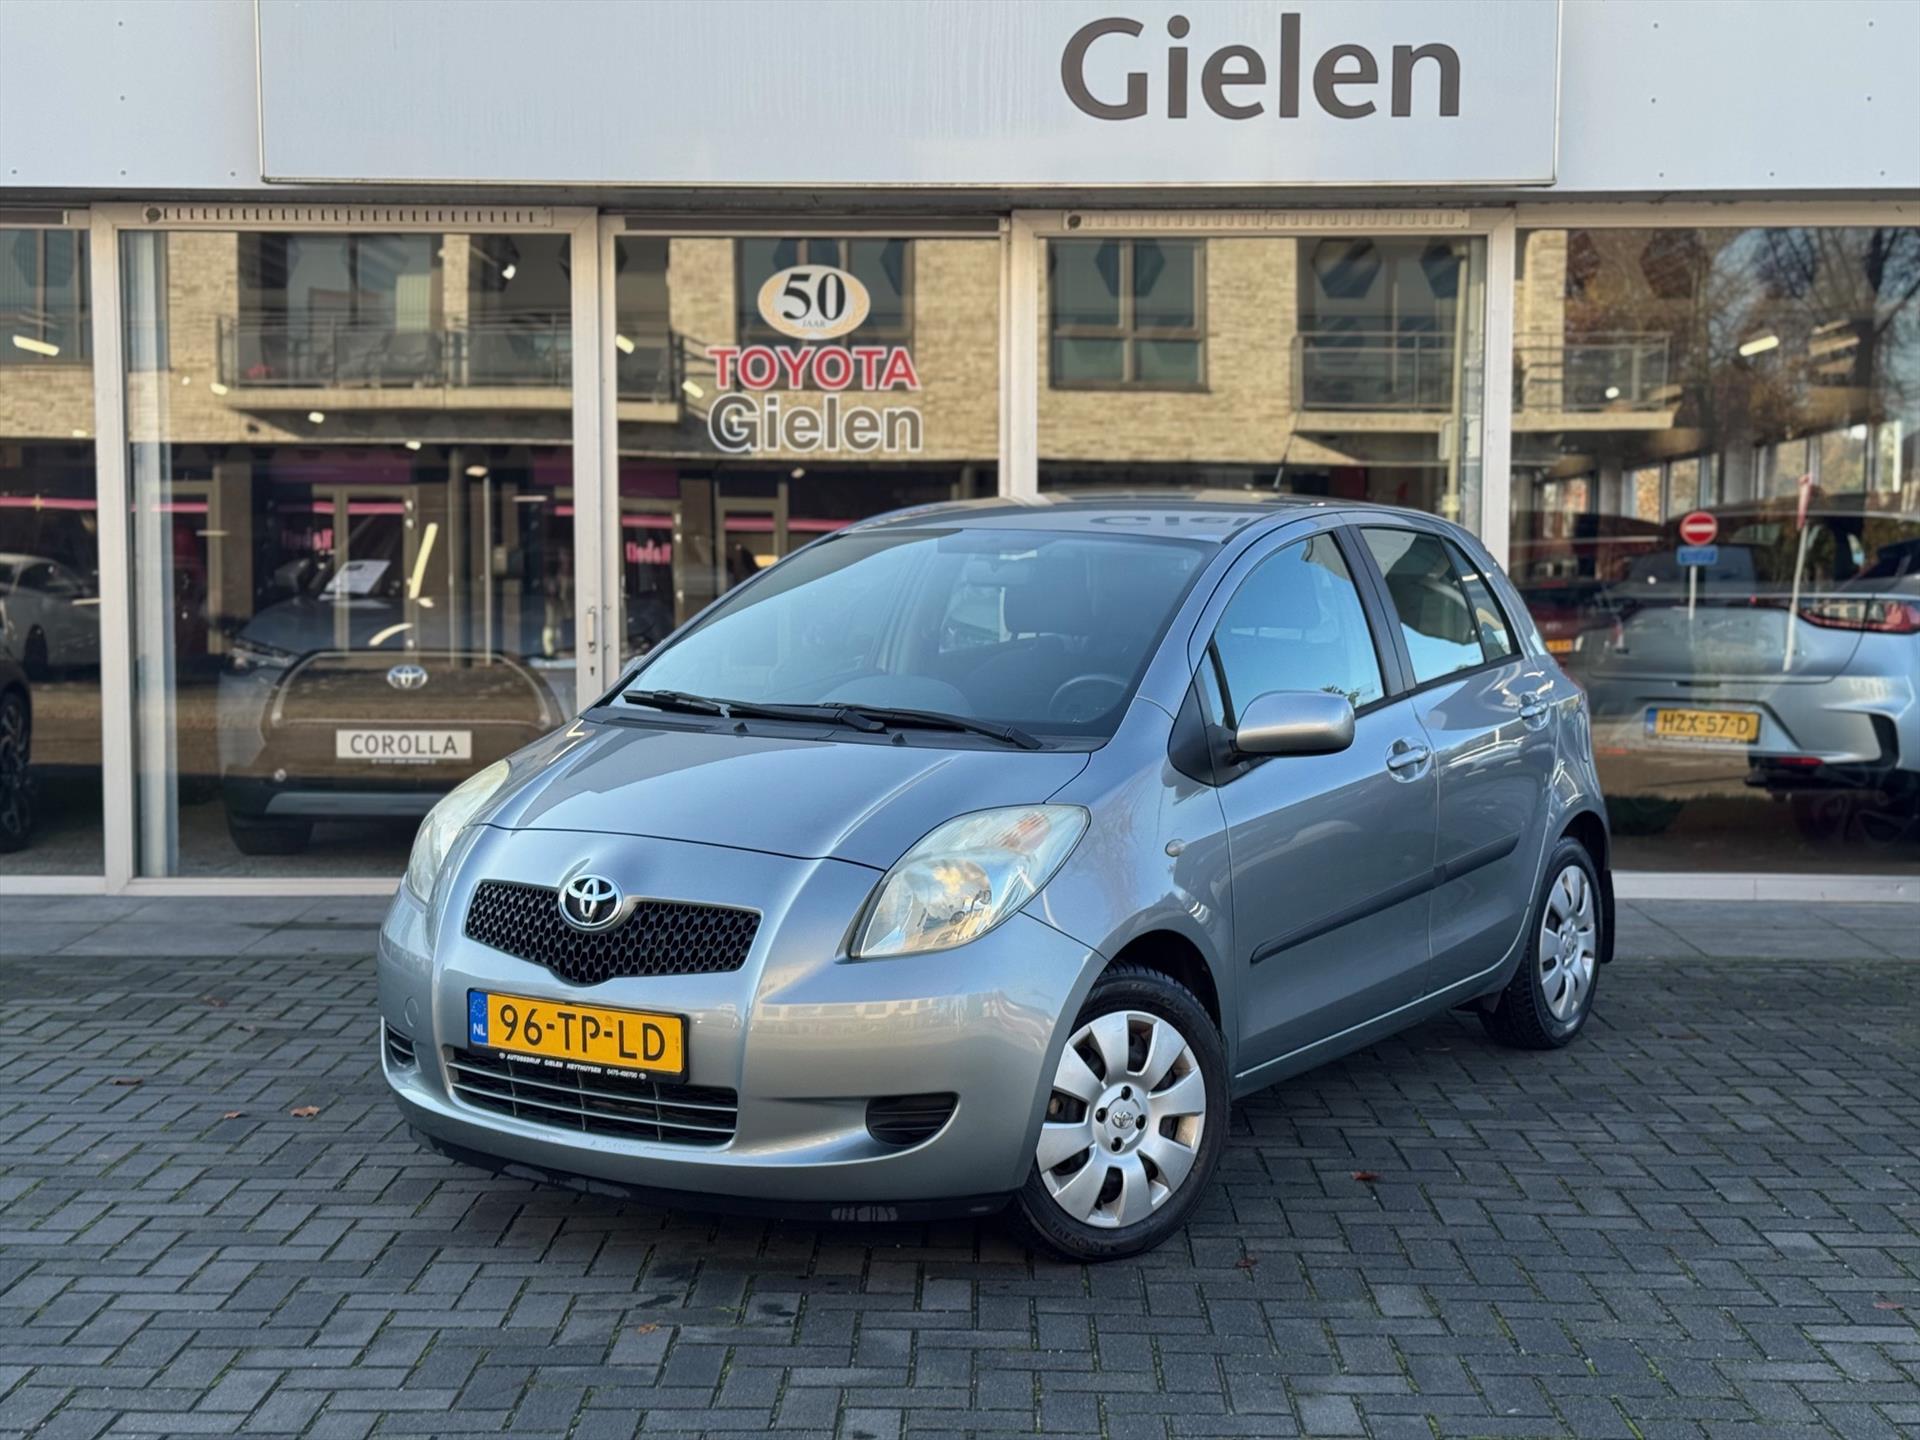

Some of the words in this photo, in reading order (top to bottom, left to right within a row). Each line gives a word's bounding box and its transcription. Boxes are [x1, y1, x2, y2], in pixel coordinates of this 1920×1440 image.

[1061, 13, 1460, 121] Gielen
[782, 272, 846, 321] 50
[802, 320, 826, 328] JAAR
[706, 346, 921, 390] TOYOTA
[708, 393, 923, 453] Gielen
[350, 734, 458, 755] COROLLA
[1662, 713, 1750, 735] HZX-57-D
[473, 1022, 487, 1036] NL
[500, 1004, 666, 1062] 96-TP-LD
